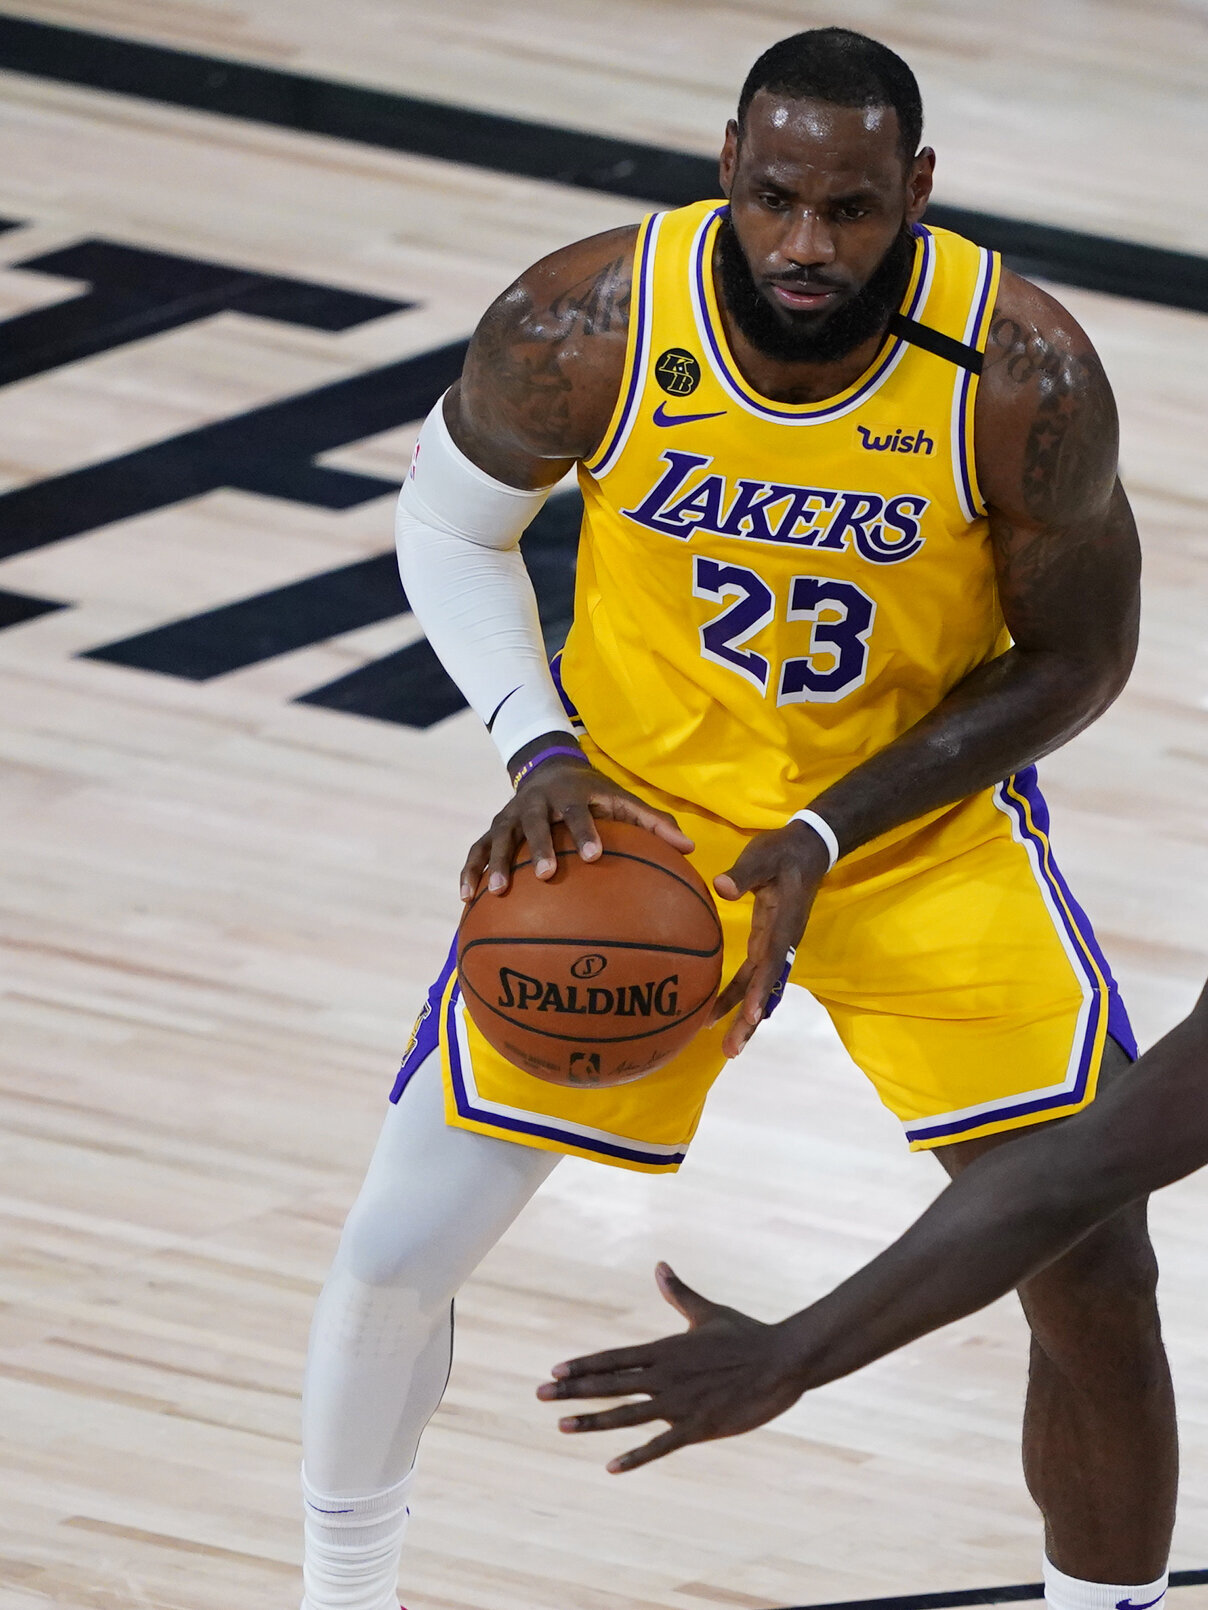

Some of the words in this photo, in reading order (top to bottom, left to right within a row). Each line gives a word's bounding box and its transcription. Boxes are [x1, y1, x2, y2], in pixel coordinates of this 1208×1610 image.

[857, 425, 933, 456] wish
[619, 449, 931, 565] LAKERS
[692, 554, 877, 708] 23
[498, 966, 679, 1017] SPALDING
